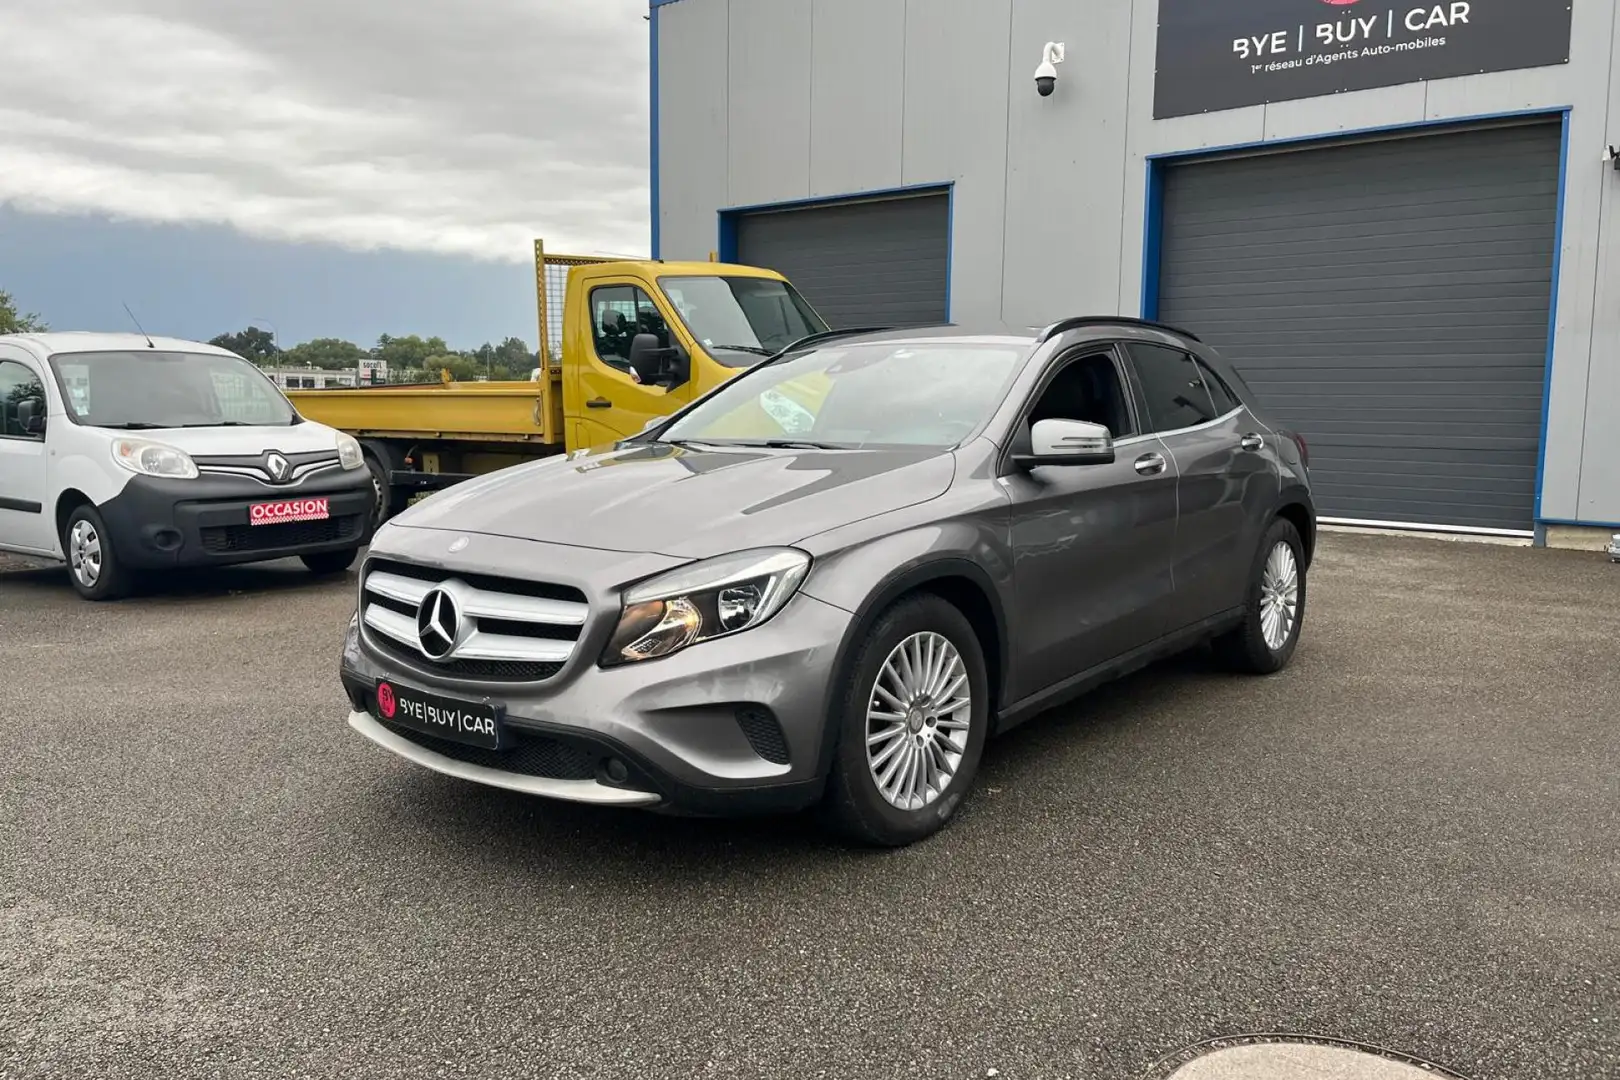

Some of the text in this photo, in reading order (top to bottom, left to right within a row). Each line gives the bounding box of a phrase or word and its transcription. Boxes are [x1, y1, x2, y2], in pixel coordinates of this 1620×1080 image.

[1233, 31, 1287, 59] BYE
[1404, 1, 1470, 31] CAR
[1265, 59, 1303, 72] réseau
[1361, 36, 1446, 56] Auto-mobiles
[252, 499, 327, 518] OCCASION
